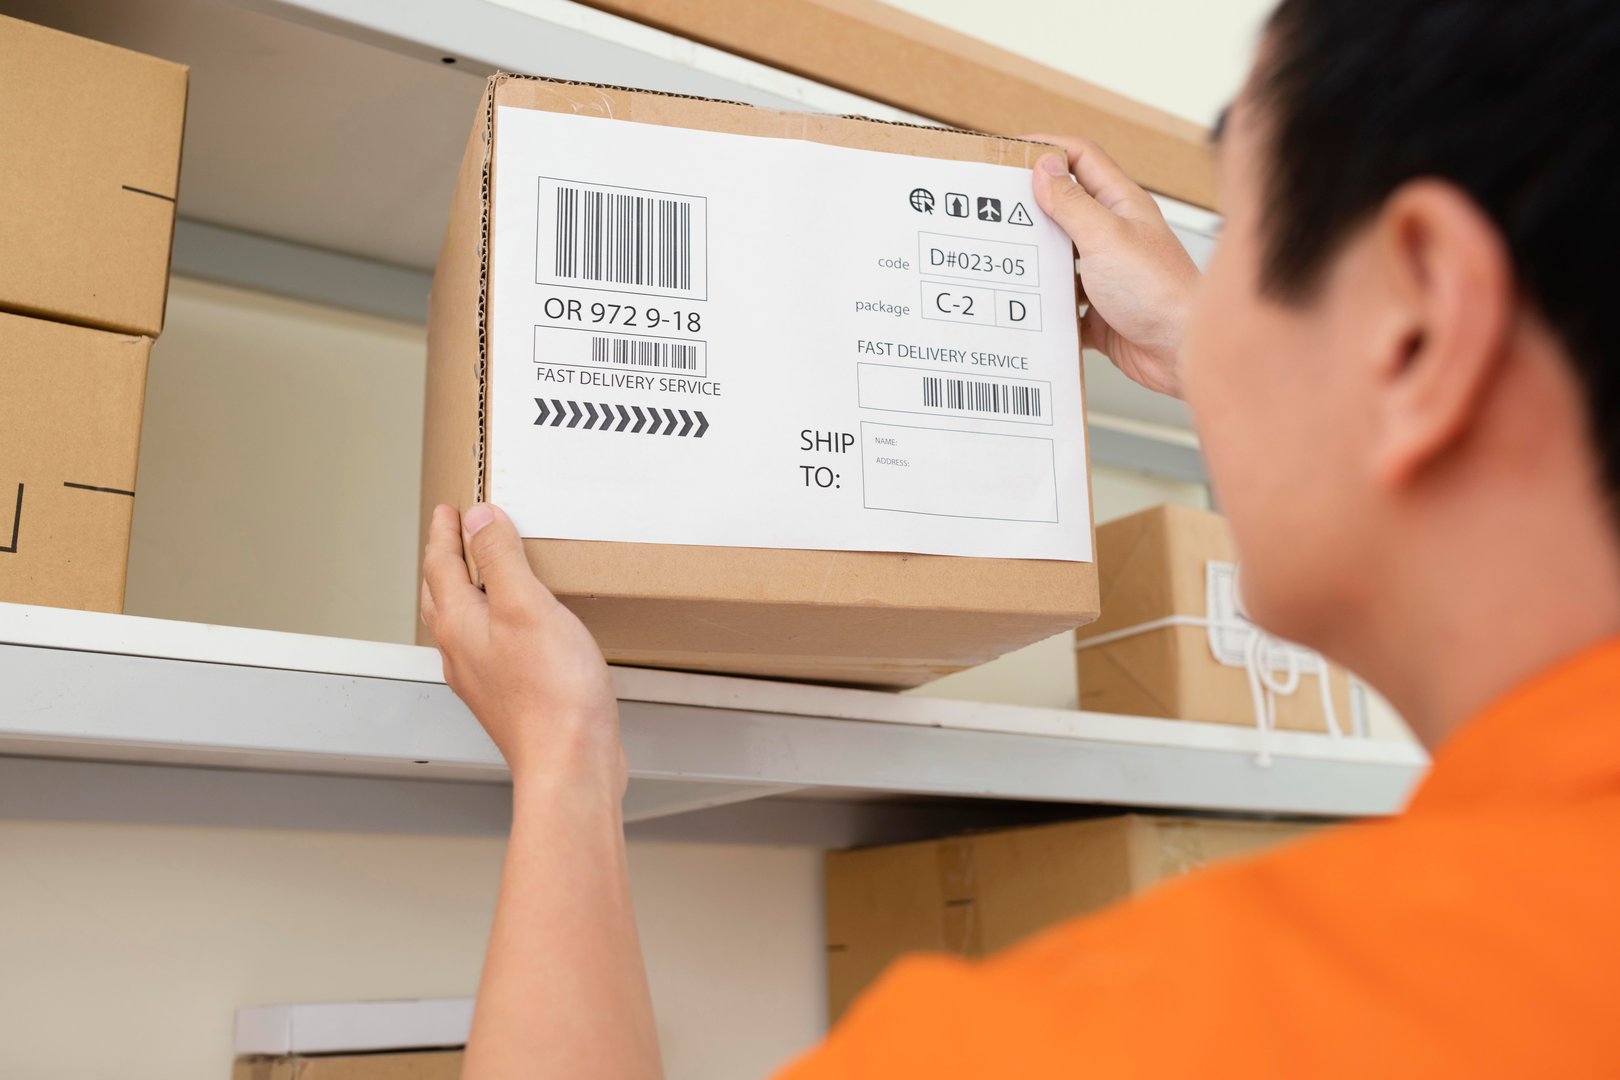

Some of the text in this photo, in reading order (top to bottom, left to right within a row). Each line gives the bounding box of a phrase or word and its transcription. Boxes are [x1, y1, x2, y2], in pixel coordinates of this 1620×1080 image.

[878, 248, 1025, 276] code D#023-05
[544, 297, 701, 333] OR 972 9-18
[855, 292, 1027, 322] package C-2 D
[858, 340, 1029, 370] FAST DELIVERY SERVICE
[537, 367, 721, 396] FAST DELIVERY SERVICE
[800, 429, 855, 454] SHIP
[875, 437, 898, 447] NAME:
[876, 456, 910, 468] ADDRESS:
[800, 465, 841, 489] TO:
